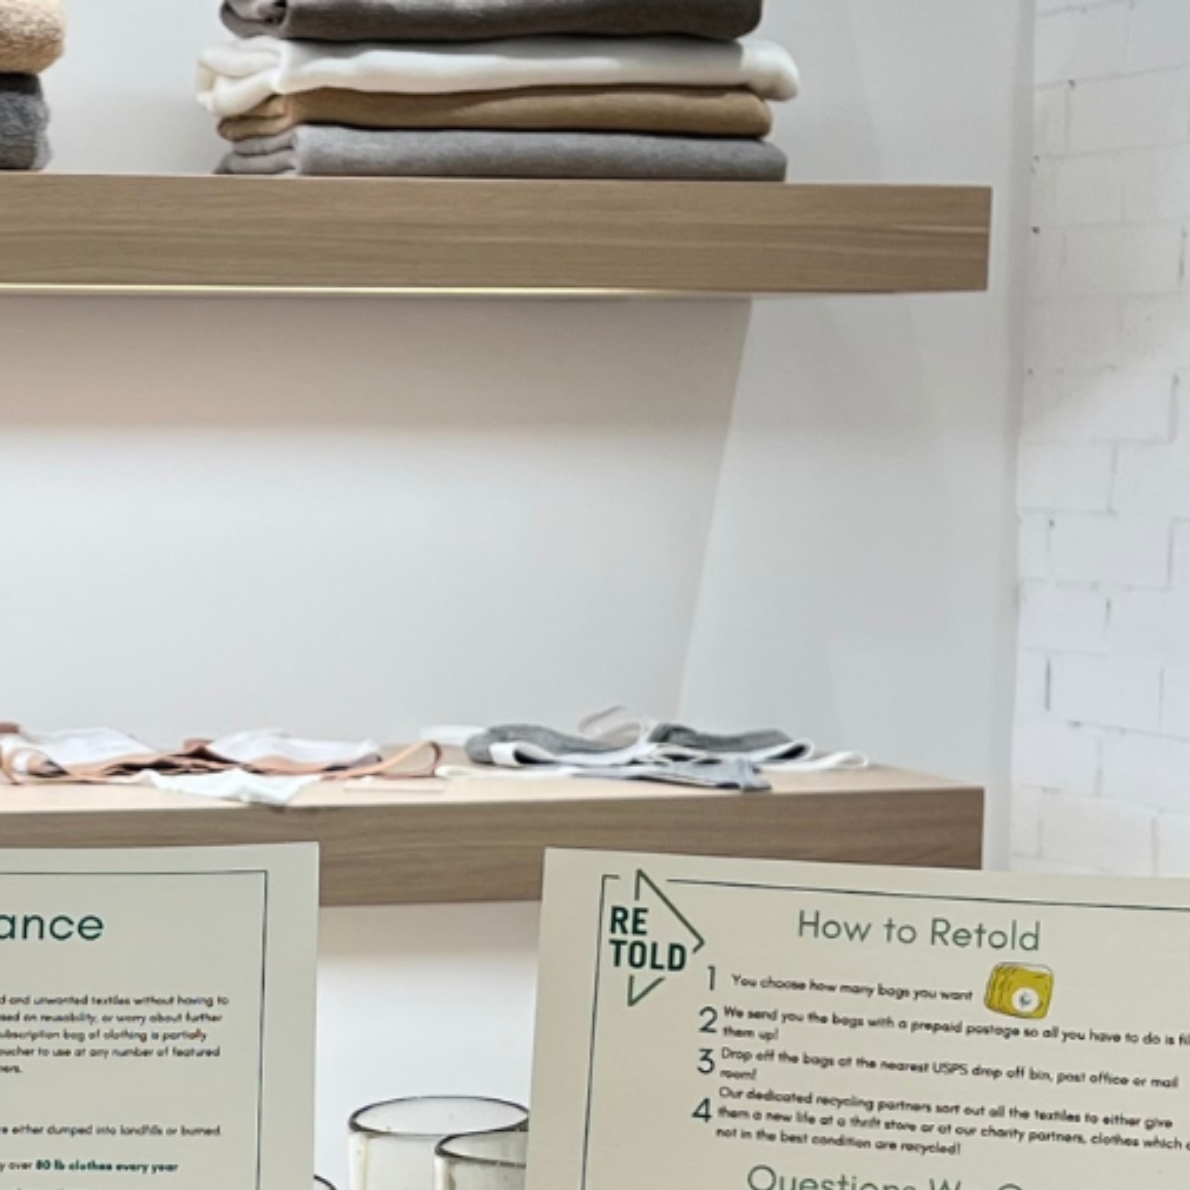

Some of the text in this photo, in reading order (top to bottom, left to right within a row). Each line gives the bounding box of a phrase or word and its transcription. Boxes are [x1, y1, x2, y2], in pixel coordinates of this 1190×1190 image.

[610, 906, 648, 936] RE
[798, 910, 1040, 951] How to Retold
[610, 940, 686, 971] TOLD
[707, 966, 716, 990] 1
[733, 974, 973, 1001] You choose how many bags you want
[698, 1007, 717, 1034] 2
[723, 1025, 779, 1042] them up!
[724, 1005, 1175, 1046] We send you the bags with a prepaid postage so all you have to do is
[697, 1048, 716, 1074] 3
[692, 1099, 712, 1123] 4
[9, 1161, 32, 1171] over
[36, 1159, 51, 1170] 80
[54, 1159, 65, 1170] lb
[69, 1159, 112, 1170] clothes
[116, 1163, 148, 1173] every
[152, 1163, 178, 1173] year
